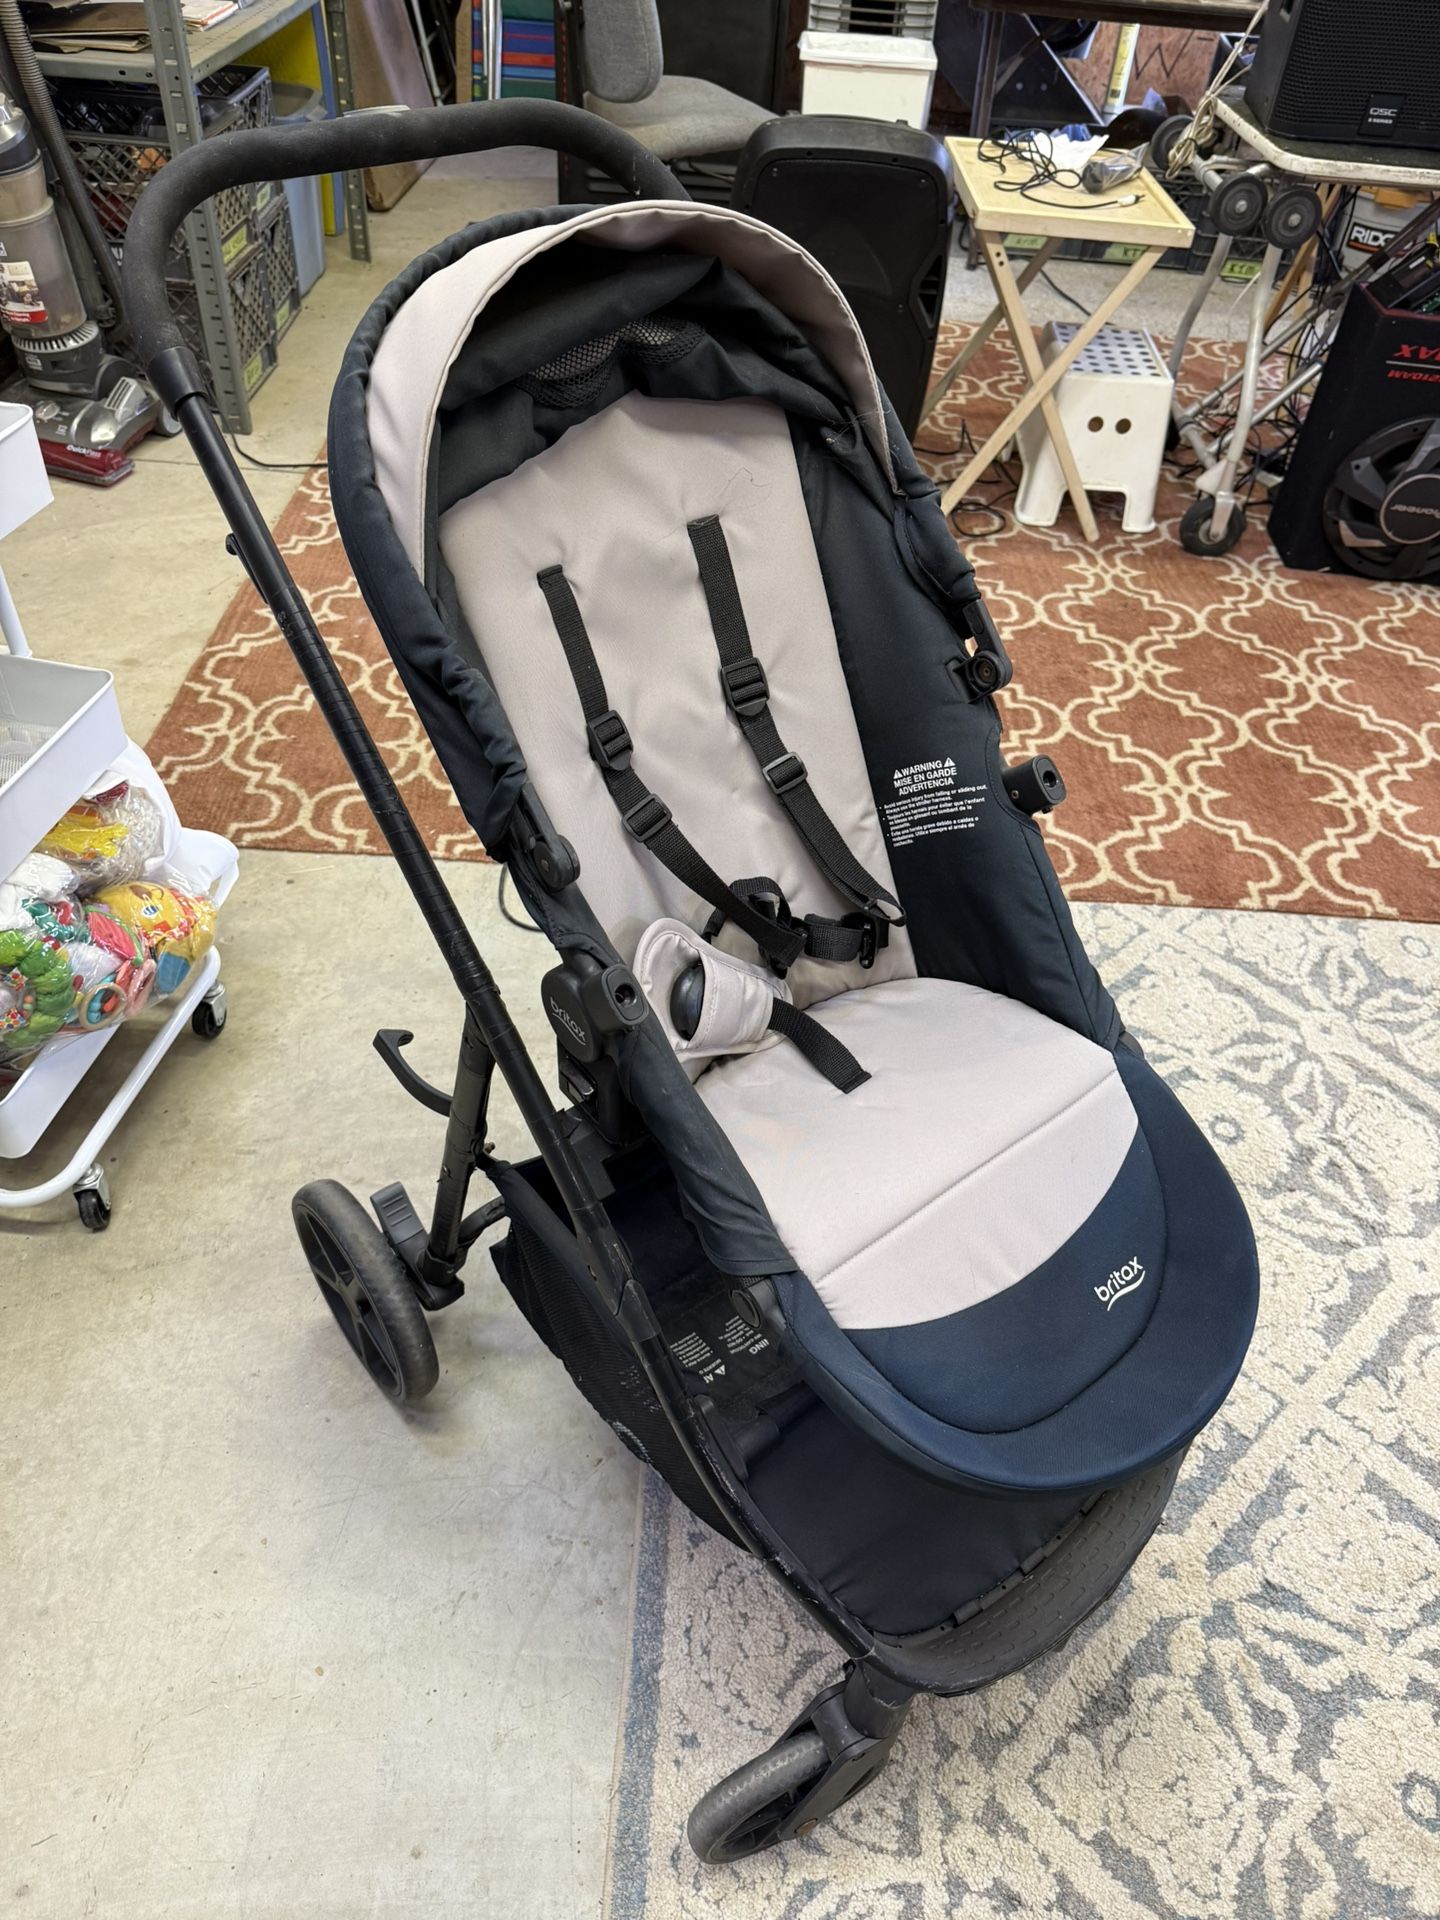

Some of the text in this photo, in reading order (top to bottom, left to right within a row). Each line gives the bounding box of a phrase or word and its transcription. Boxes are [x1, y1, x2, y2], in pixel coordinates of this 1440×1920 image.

[1369, 107, 1398, 117] QSC
[894, 767, 957, 788] MISE EN GARDE
[901, 760, 942, 776] WARNING
[899, 777, 954, 796] ADVERTENCIA
[550, 996, 586, 1042] britax
[1094, 1256, 1143, 1301] britax
